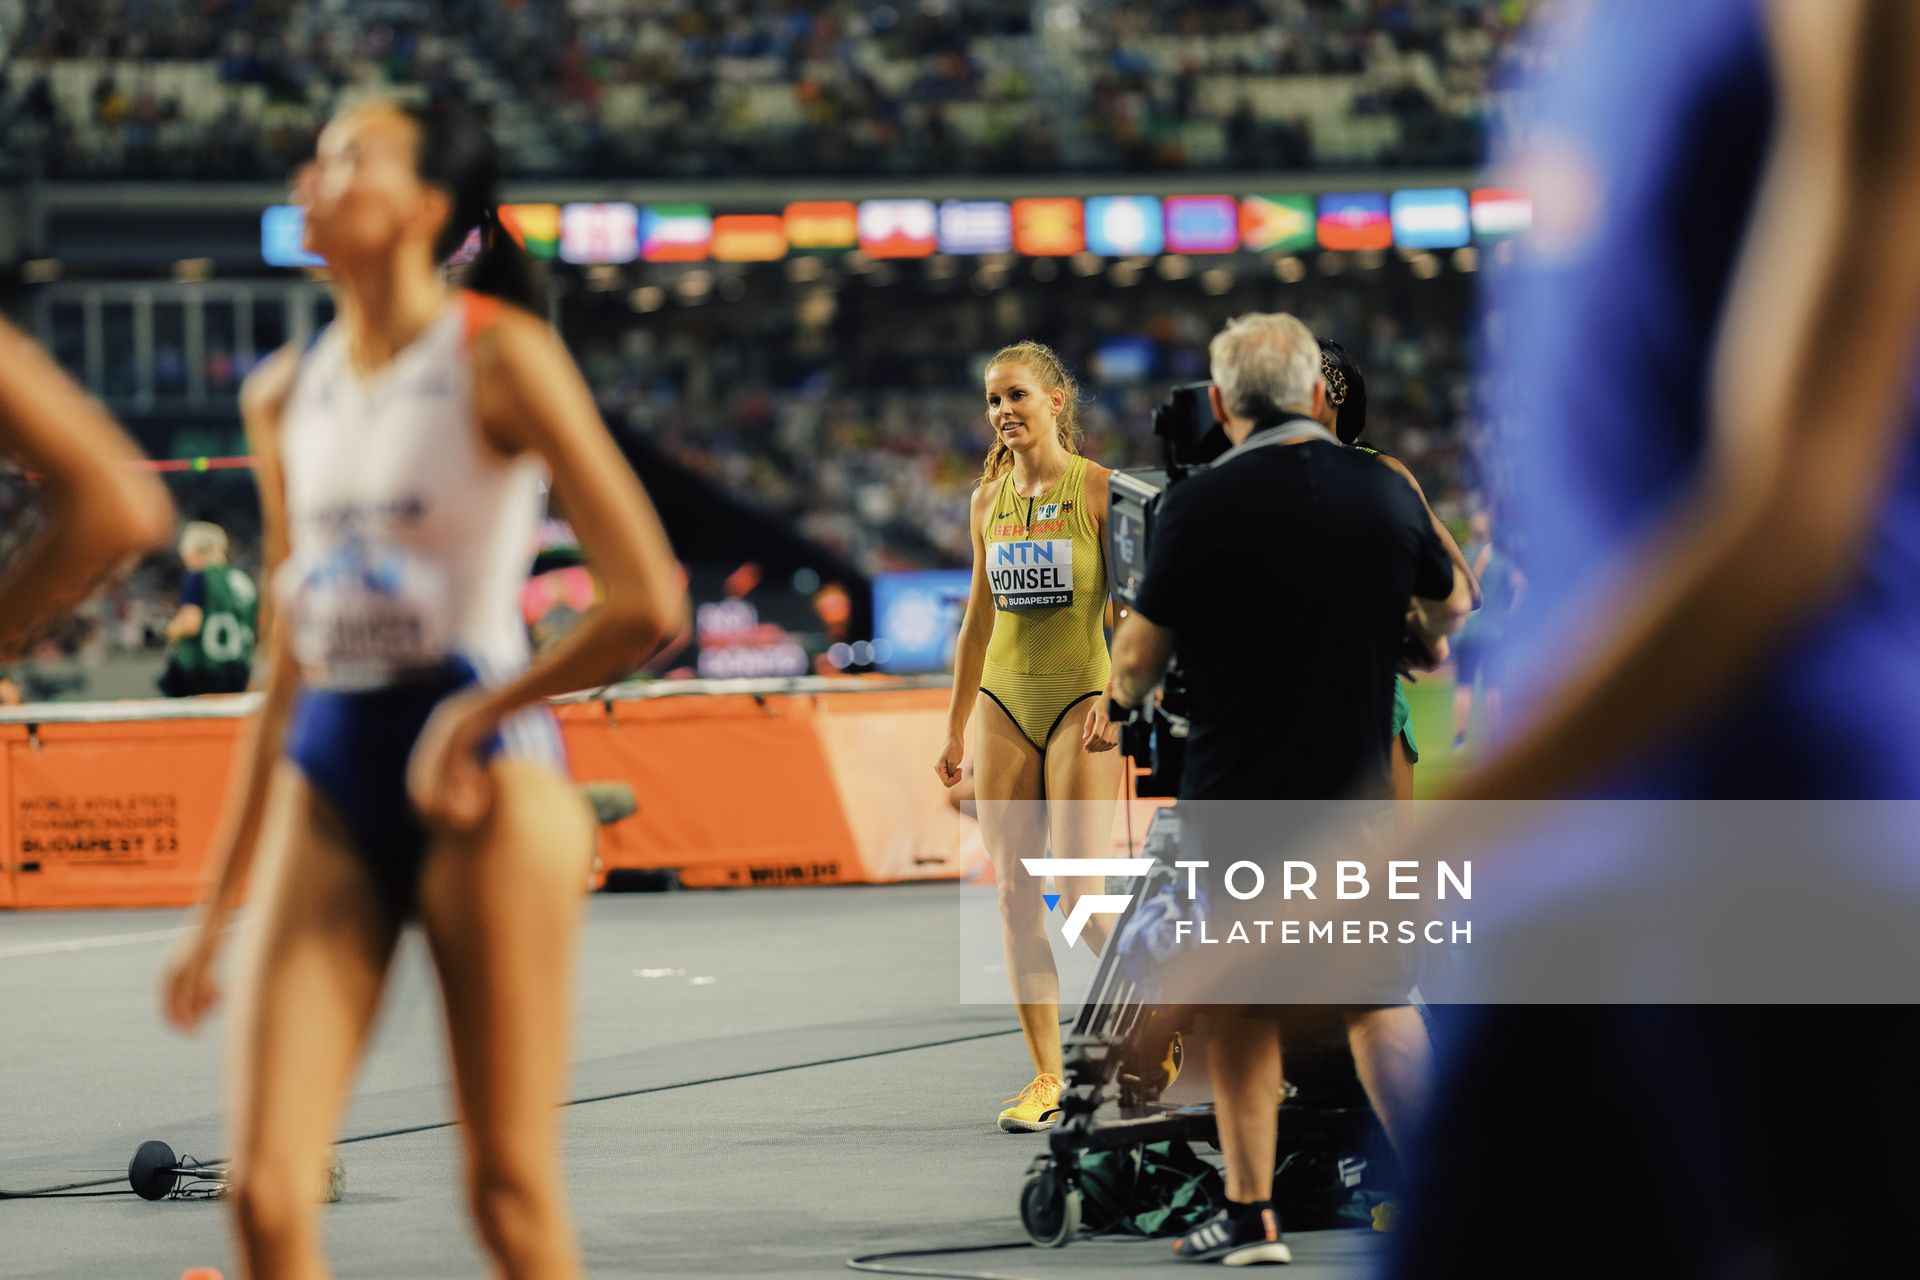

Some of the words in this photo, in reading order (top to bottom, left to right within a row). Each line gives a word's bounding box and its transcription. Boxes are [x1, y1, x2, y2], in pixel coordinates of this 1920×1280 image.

[994, 520, 1064, 537] GERMANY
[998, 541, 1053, 565] NTN
[991, 568, 1065, 590] HONSEL
[1009, 597, 1055, 606] BUDAPEST
[1056, 595, 1068, 603] 23
[21, 836, 144, 854] BUDAPEST
